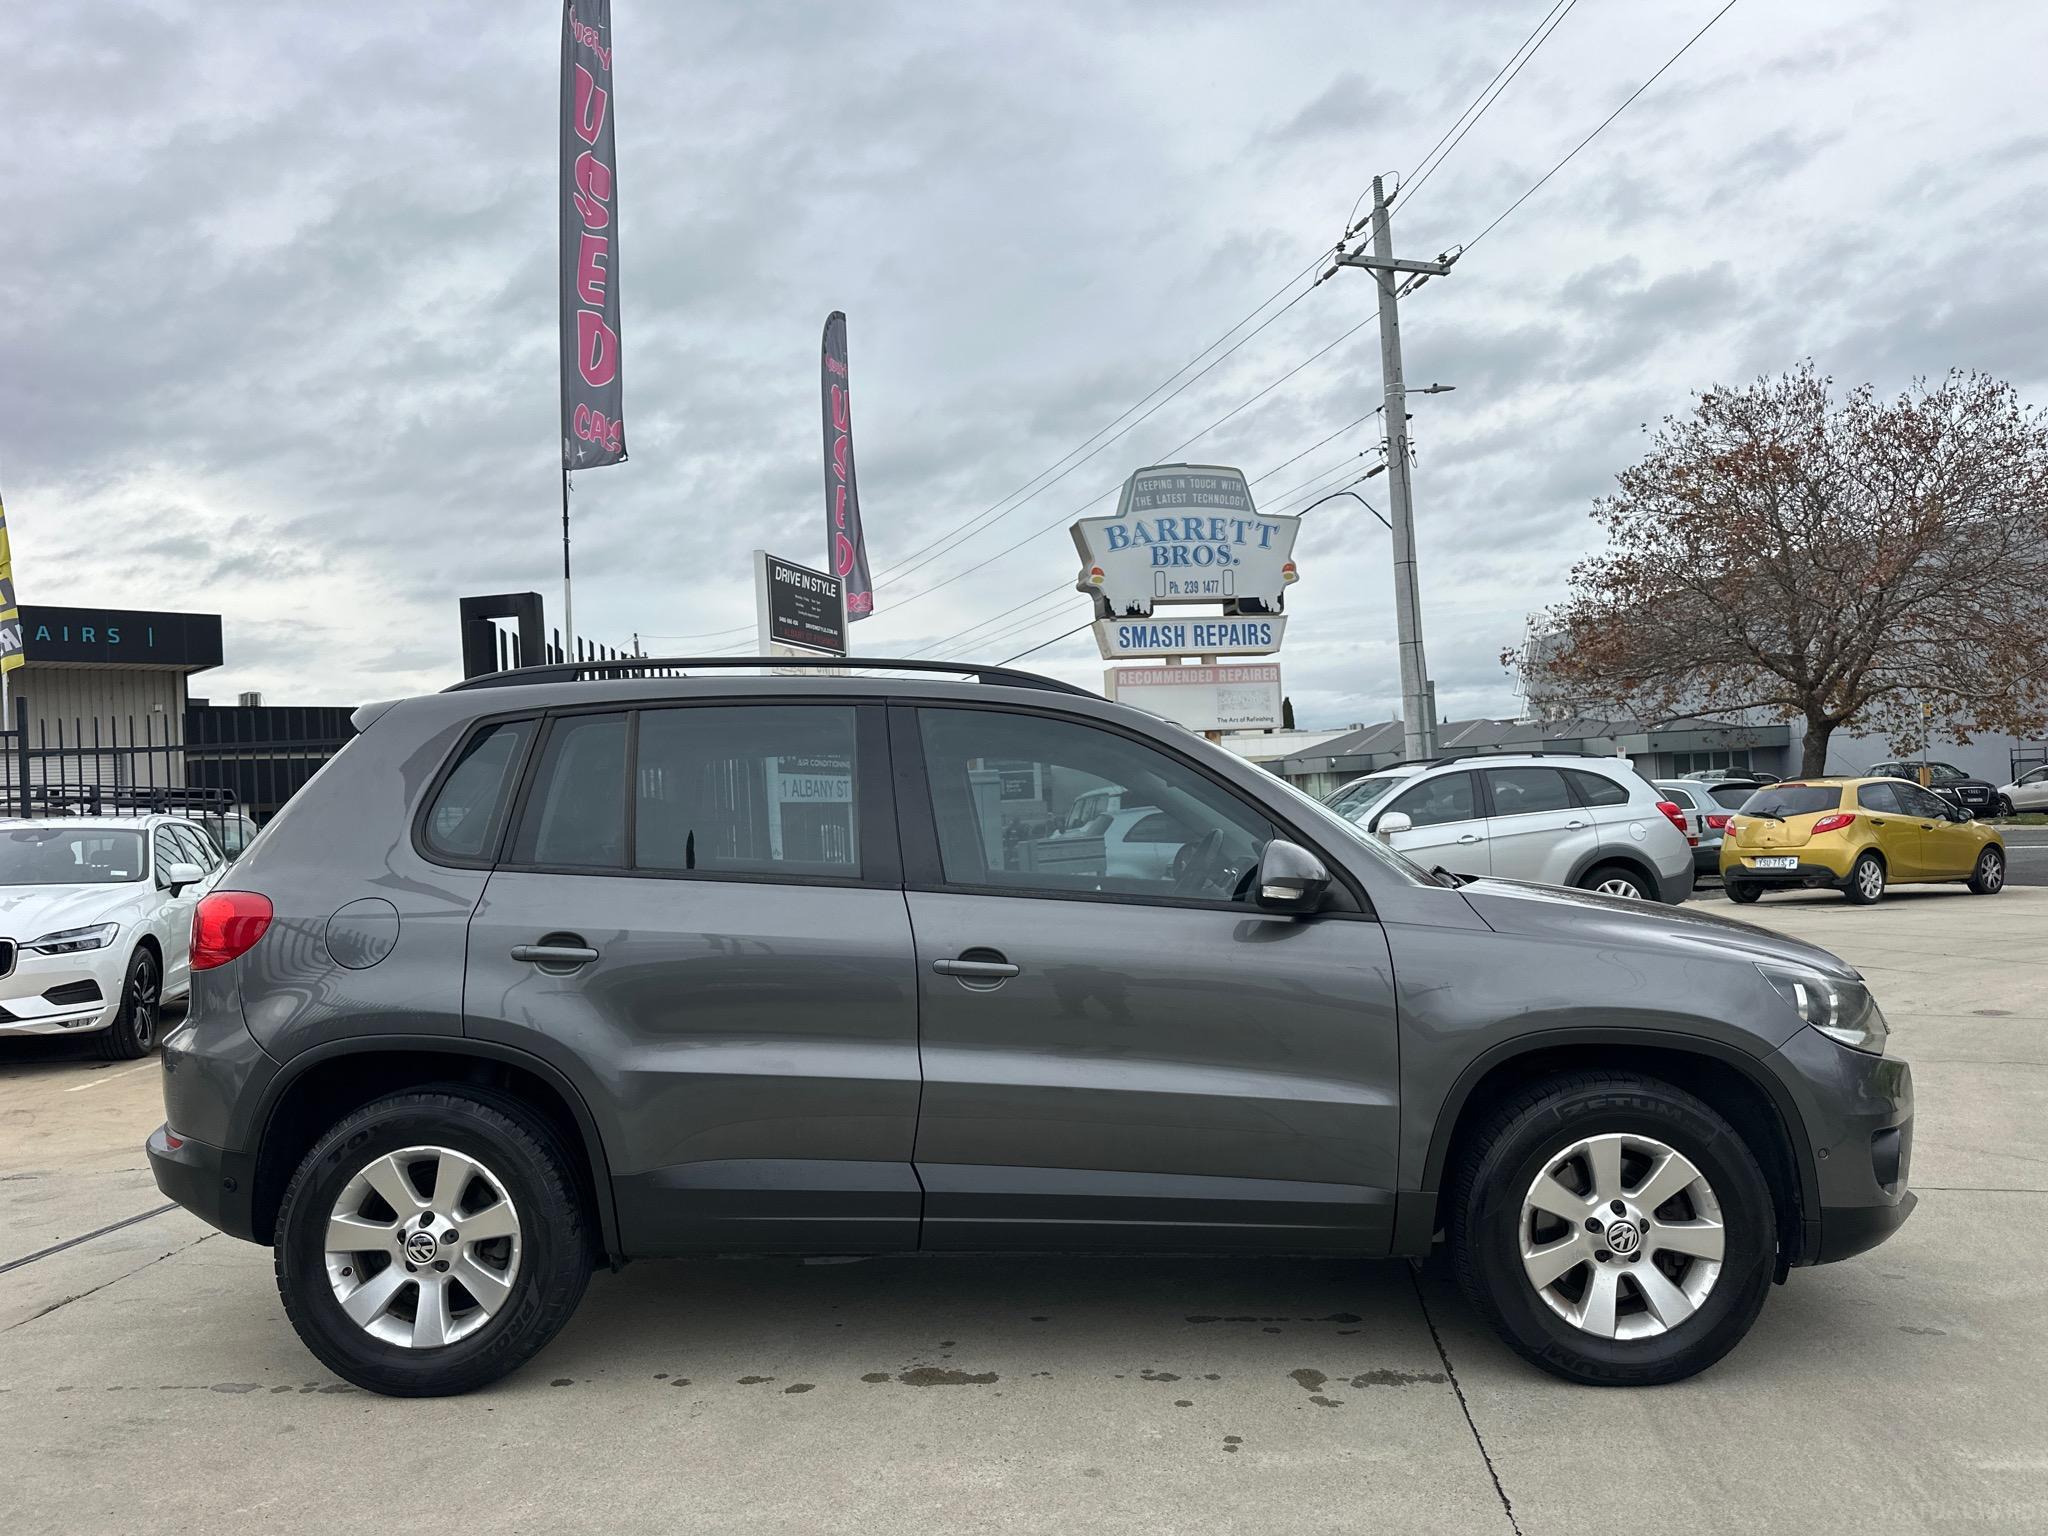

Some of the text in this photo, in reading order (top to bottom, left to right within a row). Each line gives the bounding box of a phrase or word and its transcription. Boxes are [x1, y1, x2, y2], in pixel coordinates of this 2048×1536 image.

[573, 62, 618, 388] USED
[1137, 479, 1241, 492] KEEPING IN TOUCH WITH
[1135, 493, 1246, 507] THE LATEST TECHNOLOGY
[1104, 516, 1281, 551] BARRETT
[1151, 543, 1240, 568] BROS.
[775, 566, 837, 598] DRIVE IN STYLE
[1184, 580, 1199, 594] 239
[1203, 580, 1219, 593] 1477
[1119, 623, 1272, 649] SMASH REPAIRS
[1118, 667, 1278, 685] RECOMMENDED REPAIRER
[782, 779, 849, 798] 1 ALBANY ST
[1789, 859, 1795, 867] P
